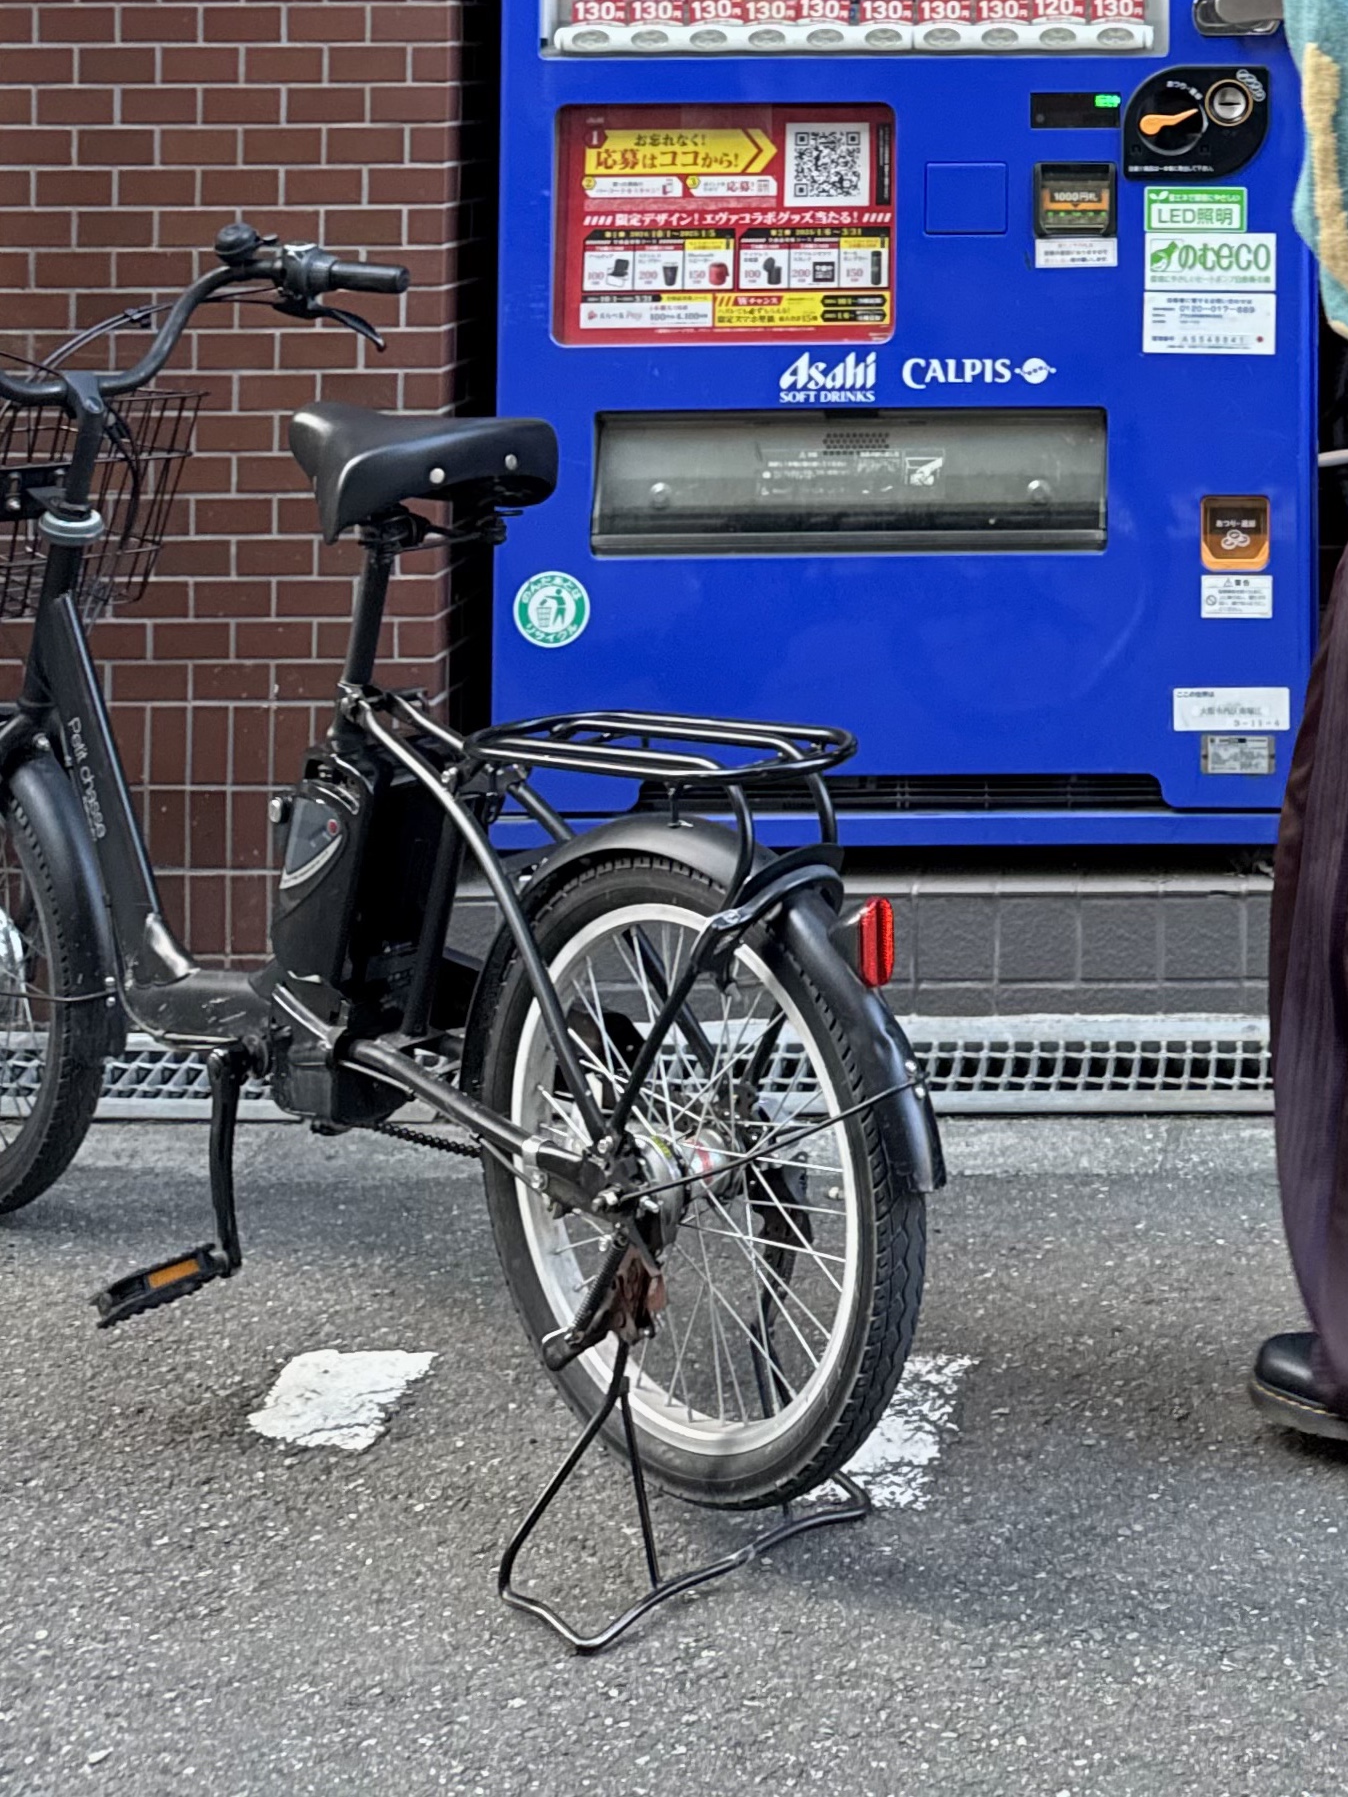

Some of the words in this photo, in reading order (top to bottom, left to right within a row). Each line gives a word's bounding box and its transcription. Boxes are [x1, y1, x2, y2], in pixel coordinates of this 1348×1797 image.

[634, 133, 706, 147] お忘れなく!
[596, 148, 739, 170] 応募はココから!
[1053, 191, 1098, 202] 1000円札
[615, 212, 699, 226] 限定デザイン!
[702, 211, 858, 226] エヴァコラボグッズ当たる!
[1158, 208, 1233, 225] LED照明
[1178, 243, 1271, 272] のむeco
[779, 351, 877, 390] Asahi
[902, 357, 1011, 389] CALPIS
[780, 390, 818, 403] SOFT
[820, 390, 876, 403] DRINKS
